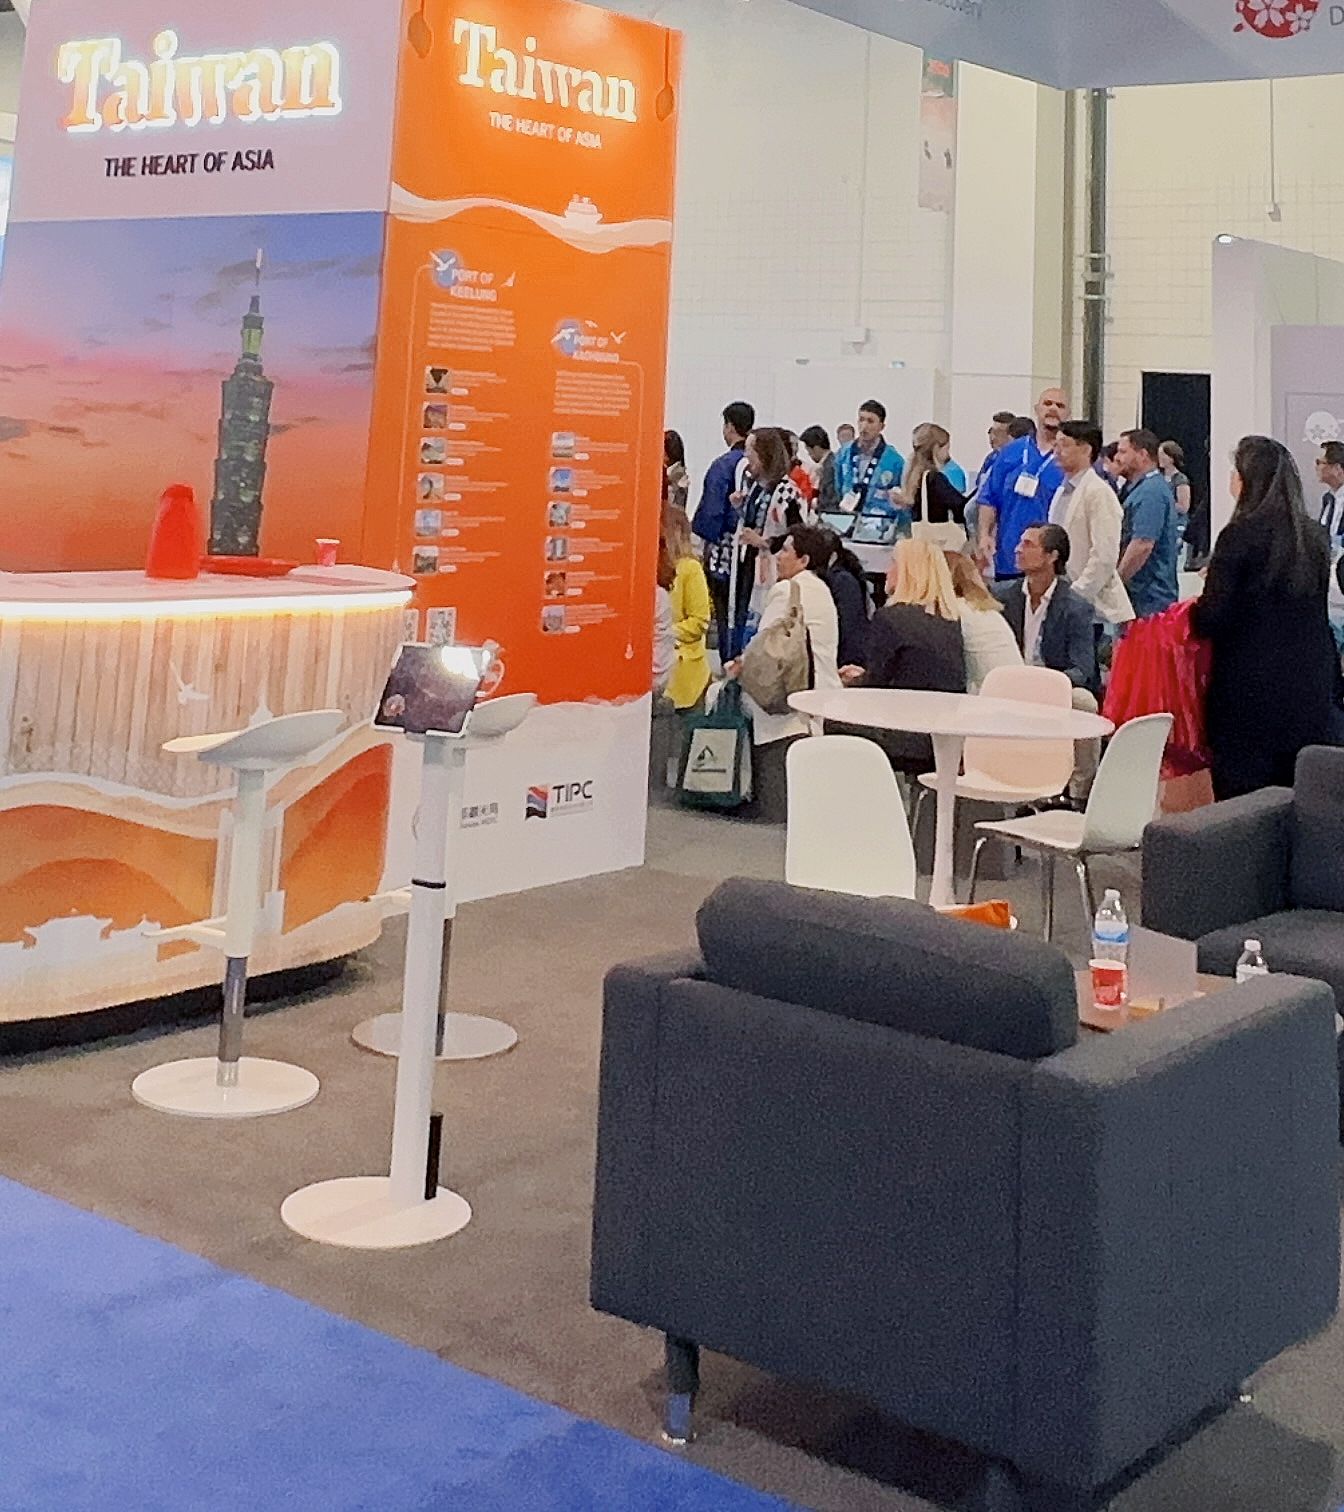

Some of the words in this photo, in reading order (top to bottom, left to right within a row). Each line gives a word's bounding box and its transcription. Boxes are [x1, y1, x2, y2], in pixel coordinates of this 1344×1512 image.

[57, 29, 343, 134] Taiwan
[452, 17, 638, 124] Taiwan
[489, 110, 514, 133] THE
[516, 117, 555, 140] HEART
[556, 126, 574, 144] OF
[575, 129, 602, 149] ASIA
[104, 156, 137, 178] THE
[141, 152, 200, 177] HEART
[203, 150, 229, 174] OF
[231, 148, 275, 172] ASIA
[552, 780, 594, 803] TIPC
